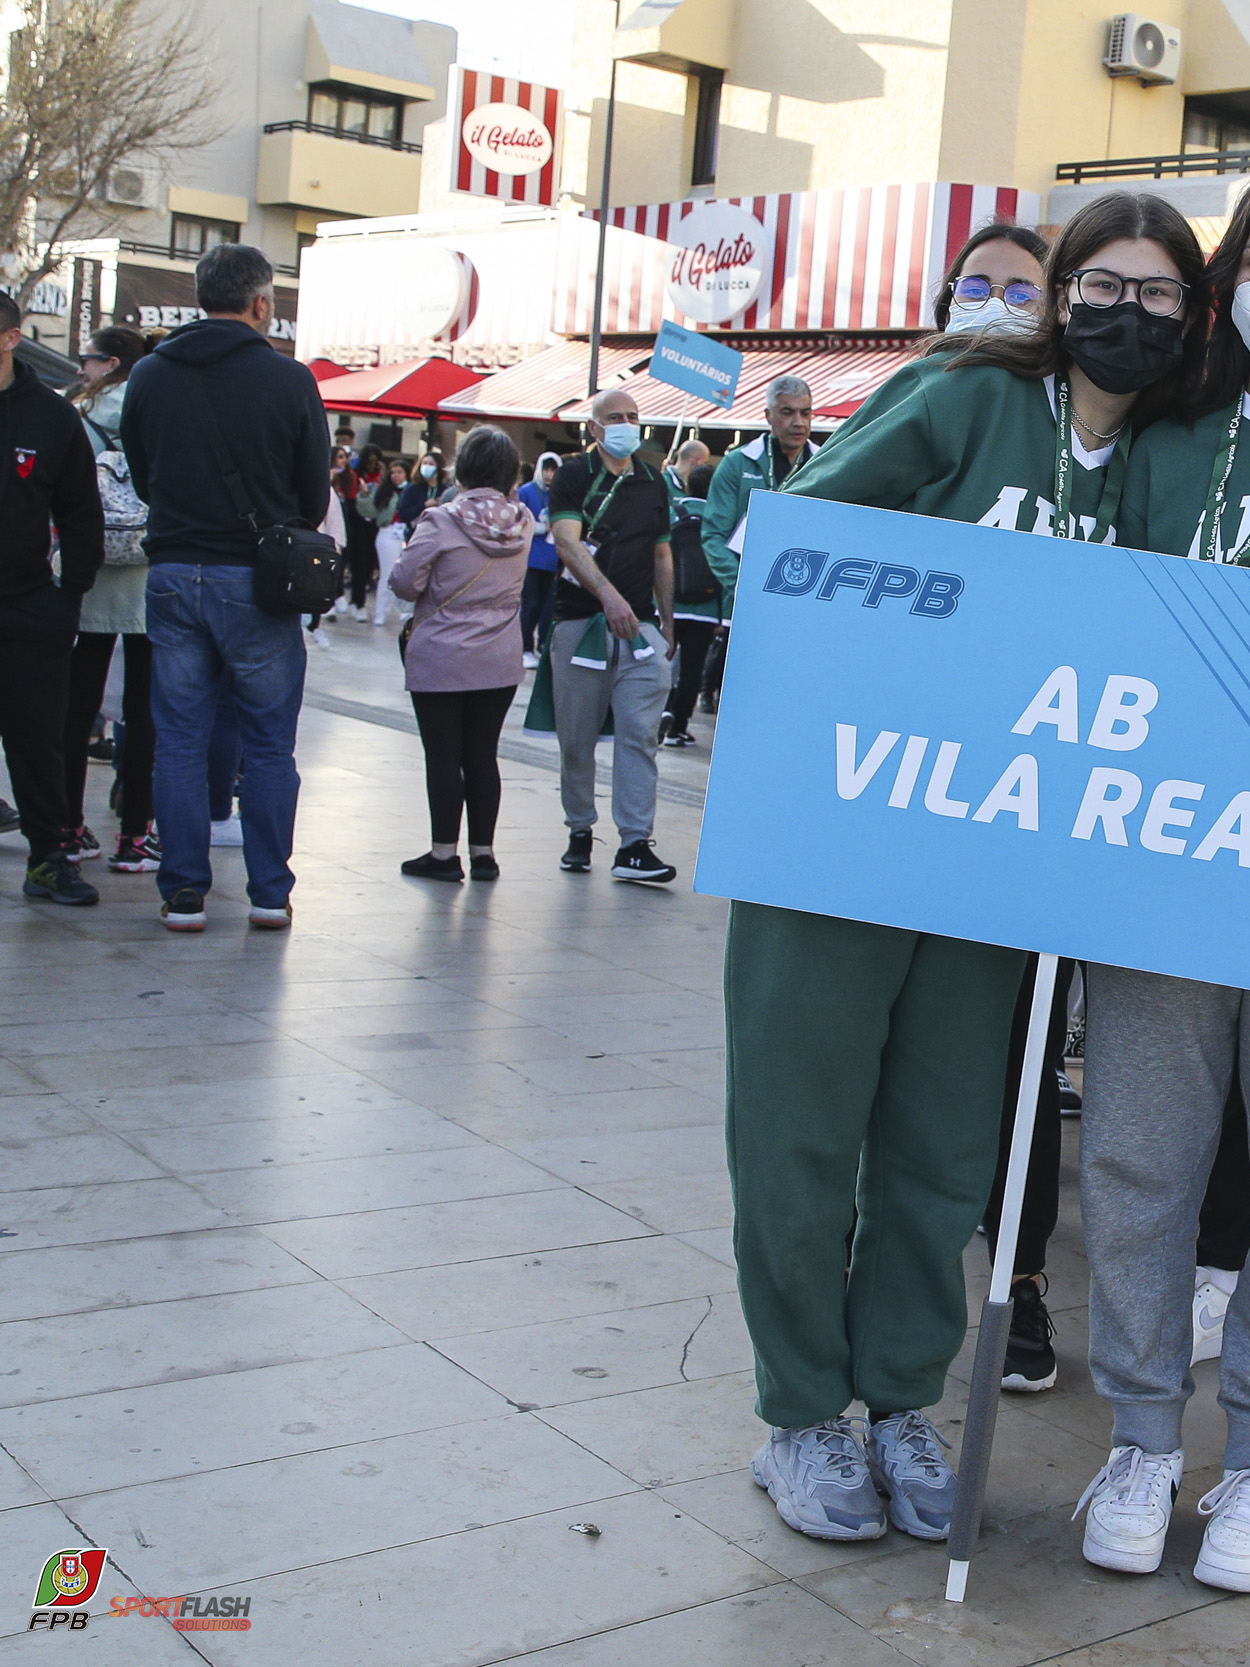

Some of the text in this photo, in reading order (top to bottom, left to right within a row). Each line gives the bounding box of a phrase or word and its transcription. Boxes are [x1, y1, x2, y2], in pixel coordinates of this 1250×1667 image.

[471, 124, 545, 154] il Gelato
[671, 232, 755, 292] il Gelato
[719, 280, 752, 291] LUCCA
[660, 345, 733, 386] VOLUNTÁRIOS
[1059, 459, 1068, 472] CA
[815, 557, 966, 620] FPB
[1010, 665, 1159, 752] AB
[835, 722, 1040, 832] VILA
